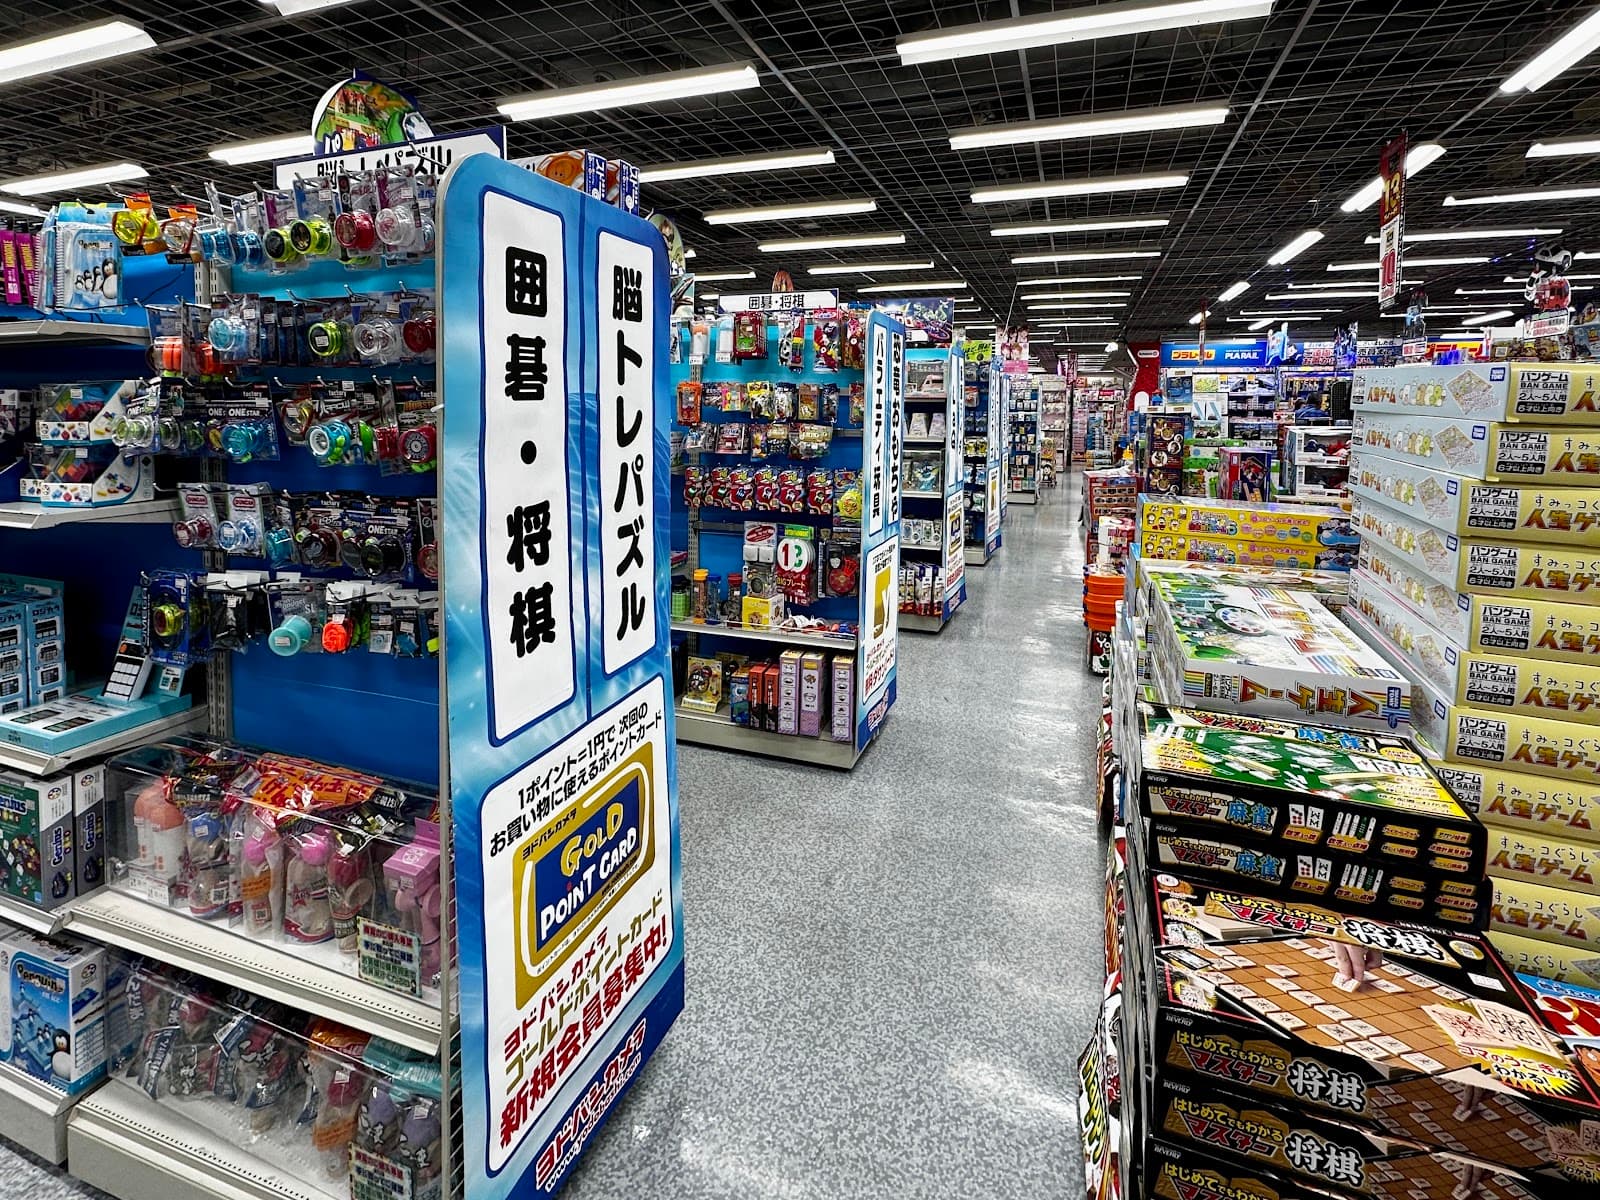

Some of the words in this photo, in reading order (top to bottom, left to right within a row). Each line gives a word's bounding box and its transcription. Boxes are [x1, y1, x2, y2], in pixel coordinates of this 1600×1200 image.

[749, 294, 805, 310] 囲碁・将棋
[228, 407, 247, 416] ONE
[505, 246, 556, 658] 囲碁・将棋
[613, 265, 645, 641] 脳トレパズル
[367, 525, 385, 535] ONE
[618, 702, 648, 735] 次回の
[489, 710, 662, 857] お買い物に使えるポイントカード
[1498, 781, 1588, 808] すみっコぐらし
[1161, 796, 1222, 816] マスター
[1227, 800, 1271, 828] 麻雀
[1487, 795, 1591, 830] 人生ゲーム
[52, 827, 63, 866] Genius
[522, 808, 577, 860] ヨドバシカメラ
[1501, 836, 1588, 862] すみっコぐらし
[599, 827, 637, 880] CARD
[1171, 846, 1230, 866] マスター
[1235, 851, 1280, 878] 麻雀
[1489, 850, 1594, 884] 人生ゲーム
[1209, 891, 1342, 925] はじめてでもわかる
[1495, 890, 1583, 918] すみっコぐらし
[1235, 904, 1329, 934] マスター
[1347, 919, 1439, 959] 将棋
[504, 926, 608, 1061] ヨドバシカメラ
[505, 889, 663, 1095] ゴールドポイントカード
[500, 915, 667, 1150] 新規会員募集中!
[1166, 1014, 1193, 1026] BEVERLY
[1176, 1030, 1286, 1071] はじめてでもわかる
[1459, 1044, 1572, 1080] コマのうごきが
[1163, 1080, 1190, 1093] BEVERLY
[1188, 1050, 1270, 1081] マスター
[1289, 1063, 1365, 1110] 将棋
[1494, 1064, 1550, 1086] わかる!
[535, 1017, 647, 1190] ヨドバシカメラ
[545, 1051, 642, 1192] www.yodobashi.com
[1174, 1097, 1283, 1142] はじめてでもわかる
[1154, 1145, 1181, 1158] BEVERLY
[1186, 1115, 1267, 1150] マスター
[1286, 1135, 1362, 1185] 将棋
